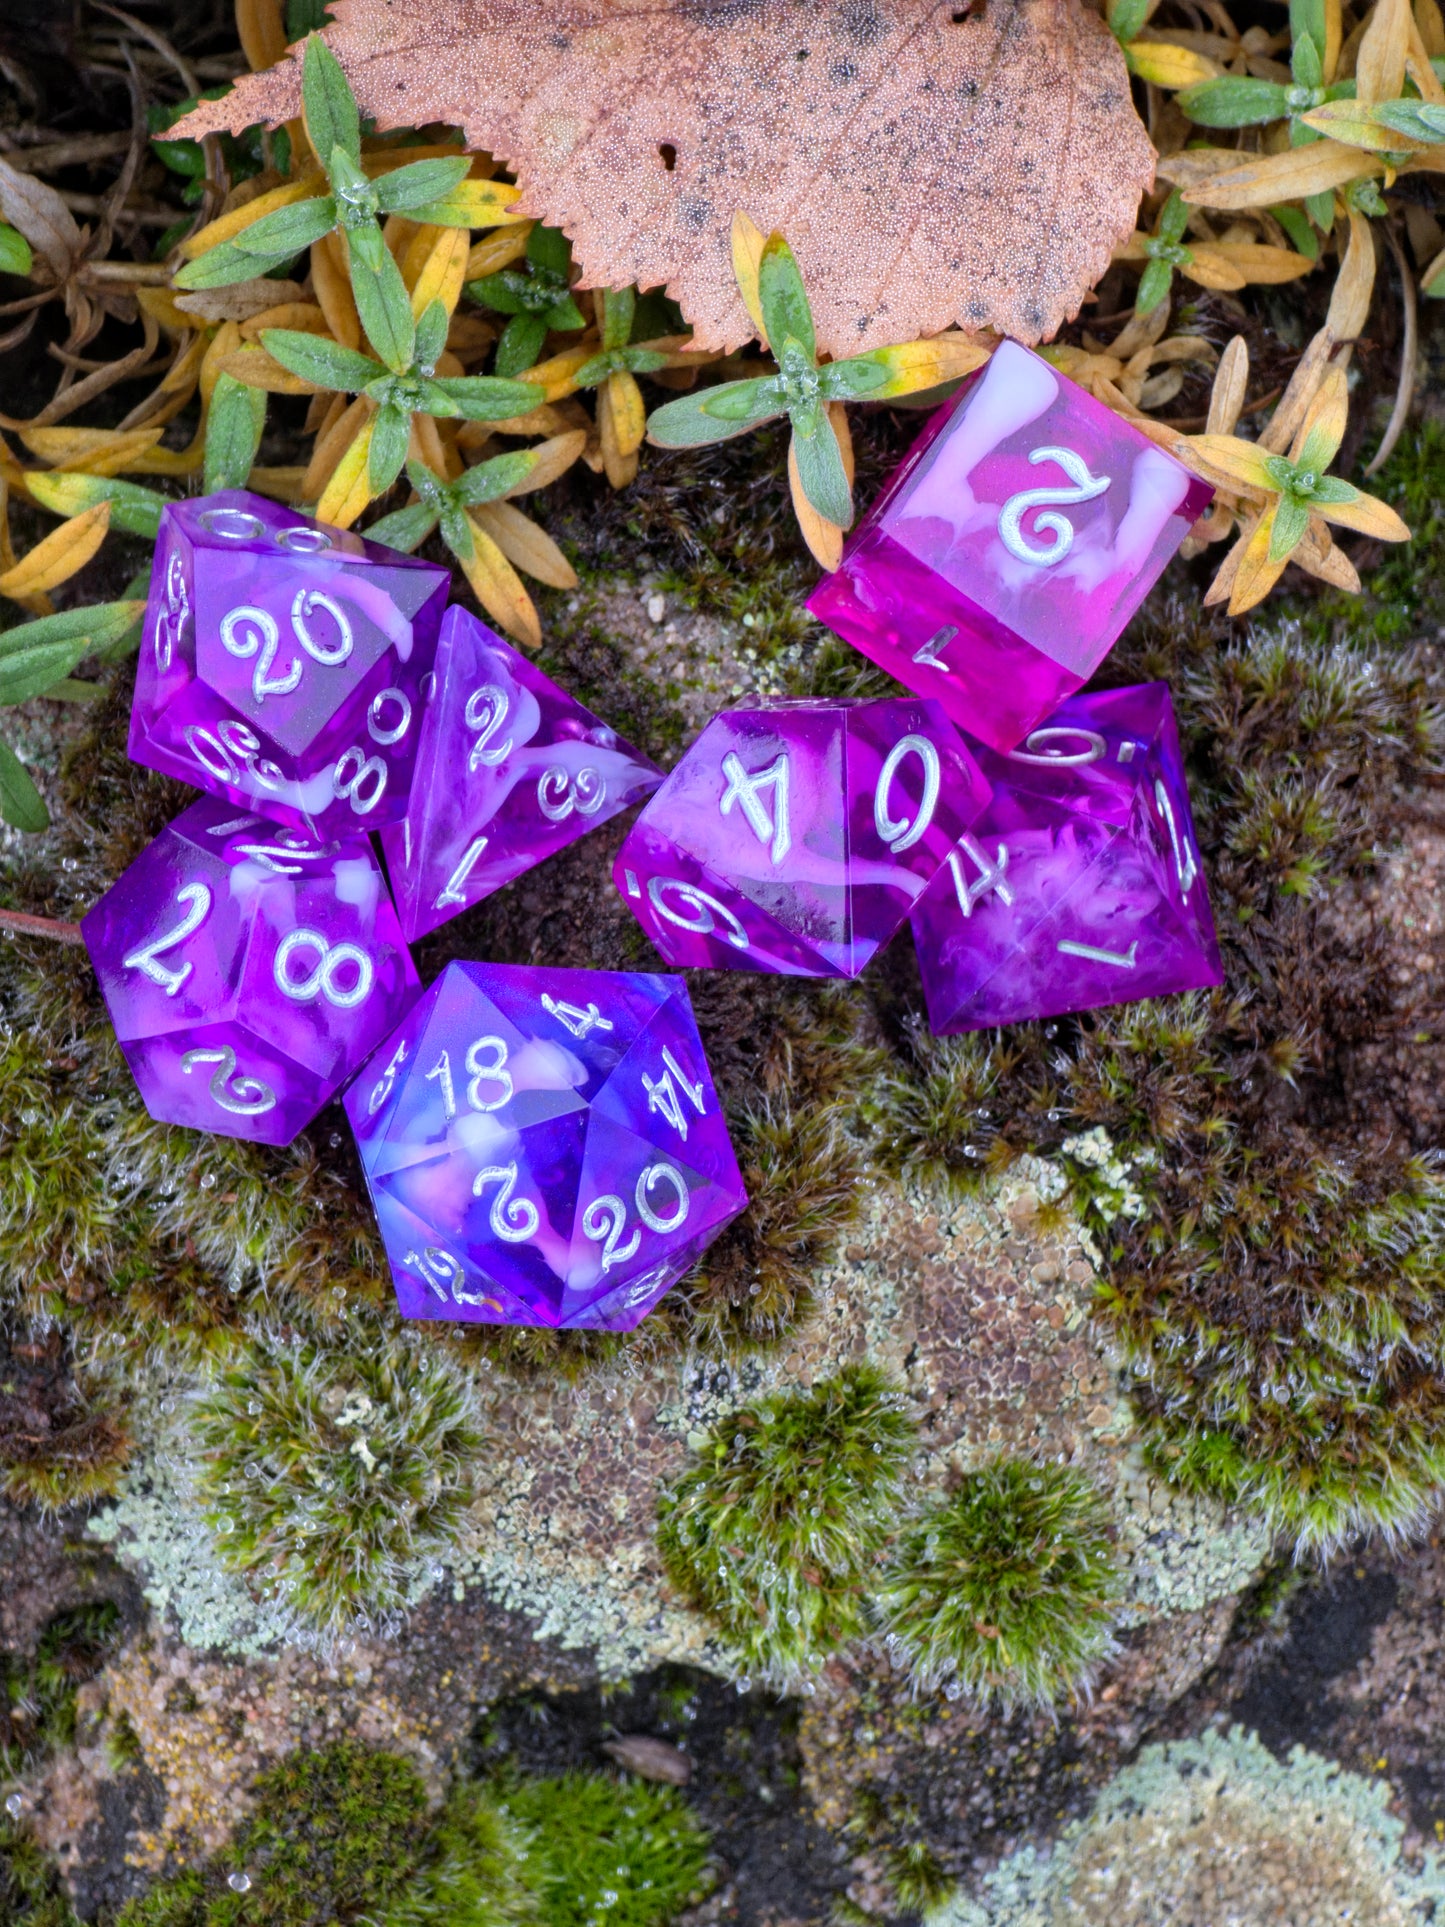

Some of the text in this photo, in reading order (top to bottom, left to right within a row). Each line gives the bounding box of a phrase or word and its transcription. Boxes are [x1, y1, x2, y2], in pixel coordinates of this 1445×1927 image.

[1000, 446, 1112, 568] 2
[219, 588, 354, 704] 20
[332, 686, 412, 816] 80
[464, 684, 514, 773] 2
[537, 765, 607, 822] 3
[720, 749, 792, 866] 4
[874, 733, 941, 854] 0
[430, 836, 489, 911] 1
[949, 831, 1016, 918] 4
[273, 927, 375, 1009] 8
[540, 993, 614, 1040] 4
[425, 1035, 515, 1121] 18
[640, 1044, 707, 1143] 14
[472, 1159, 540, 1243] 2
[581, 1162, 691, 1274] 20
[402, 1246, 486, 1305] 12
